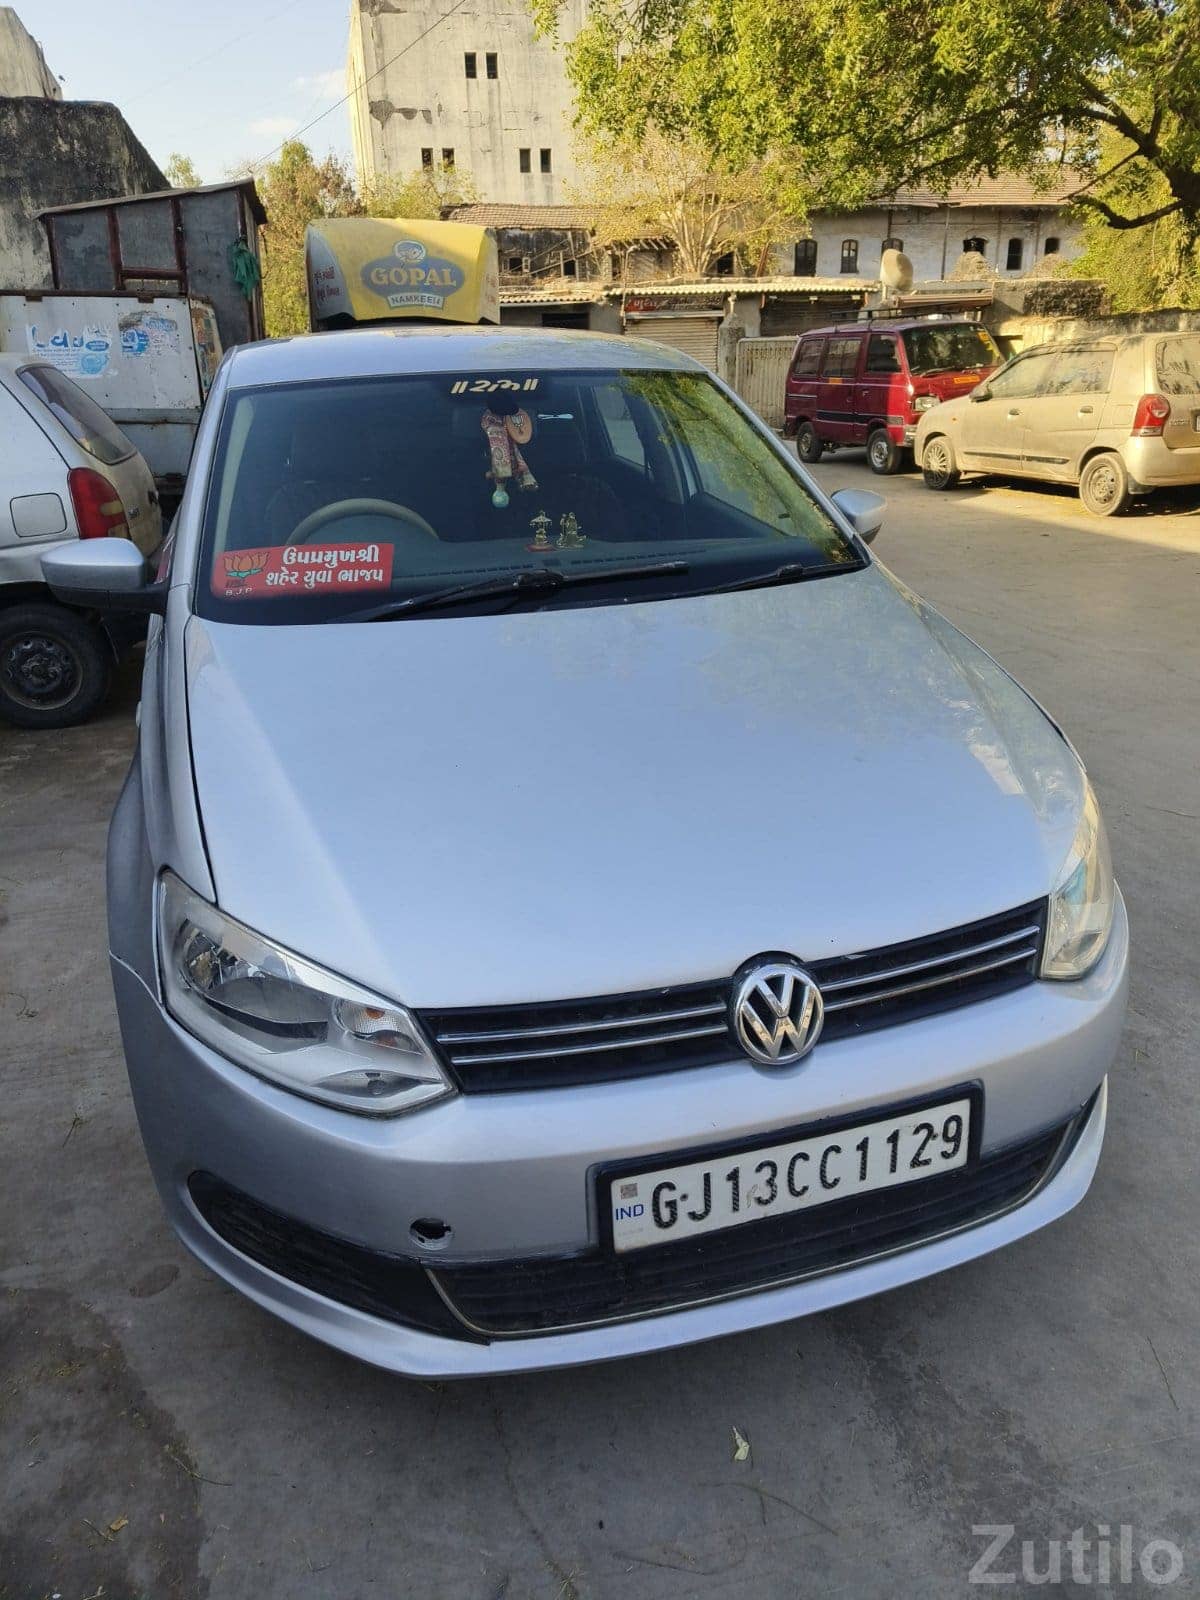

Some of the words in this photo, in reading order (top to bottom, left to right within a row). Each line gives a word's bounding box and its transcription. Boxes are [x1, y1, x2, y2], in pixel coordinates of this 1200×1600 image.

[371, 267, 457, 287] GOPAL
[265, 566, 299, 586] શહેર
[303, 570, 332, 589] યુવા
[337, 569, 384, 583] ભાજપ
[615, 1203, 645, 1221] IND
[651, 1113, 964, 1230] GJ13CC1129
